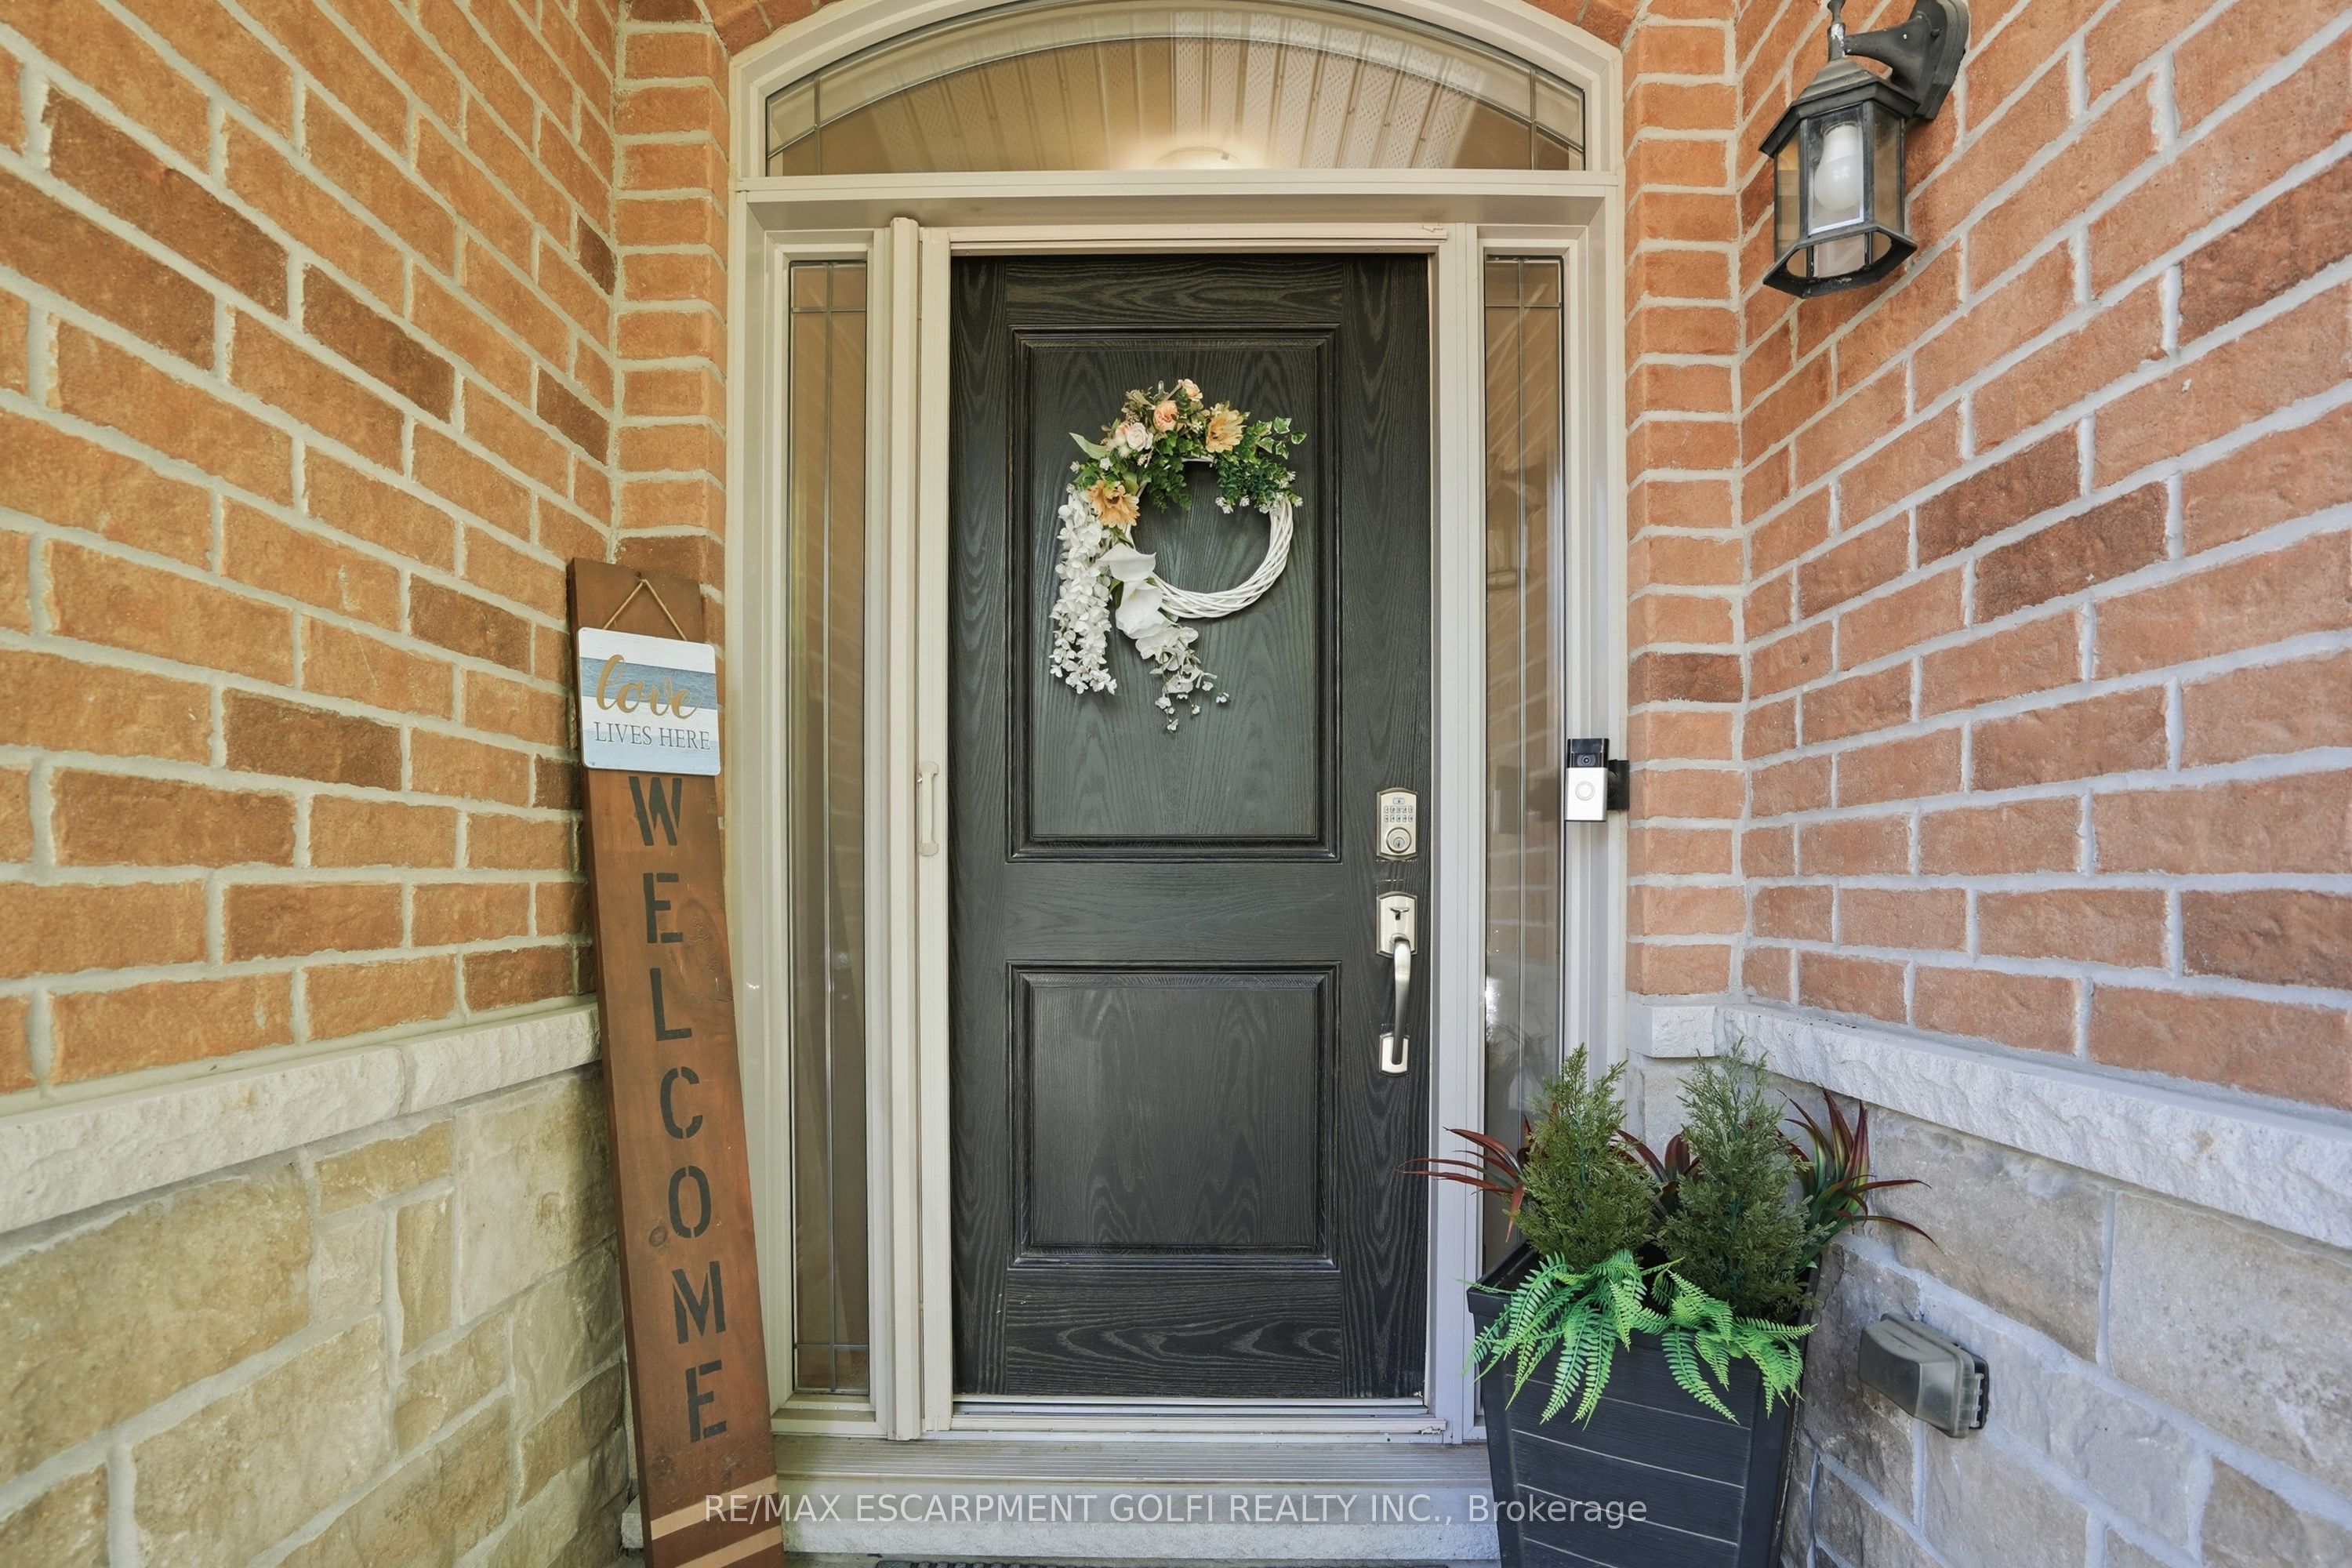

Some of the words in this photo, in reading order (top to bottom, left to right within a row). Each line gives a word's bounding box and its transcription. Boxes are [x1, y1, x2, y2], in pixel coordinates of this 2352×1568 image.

[596, 654, 703, 720] love
[593, 721, 652, 746] LIVES
[659, 727, 710, 750] HERE
[629, 776, 727, 1442] WELCOME
